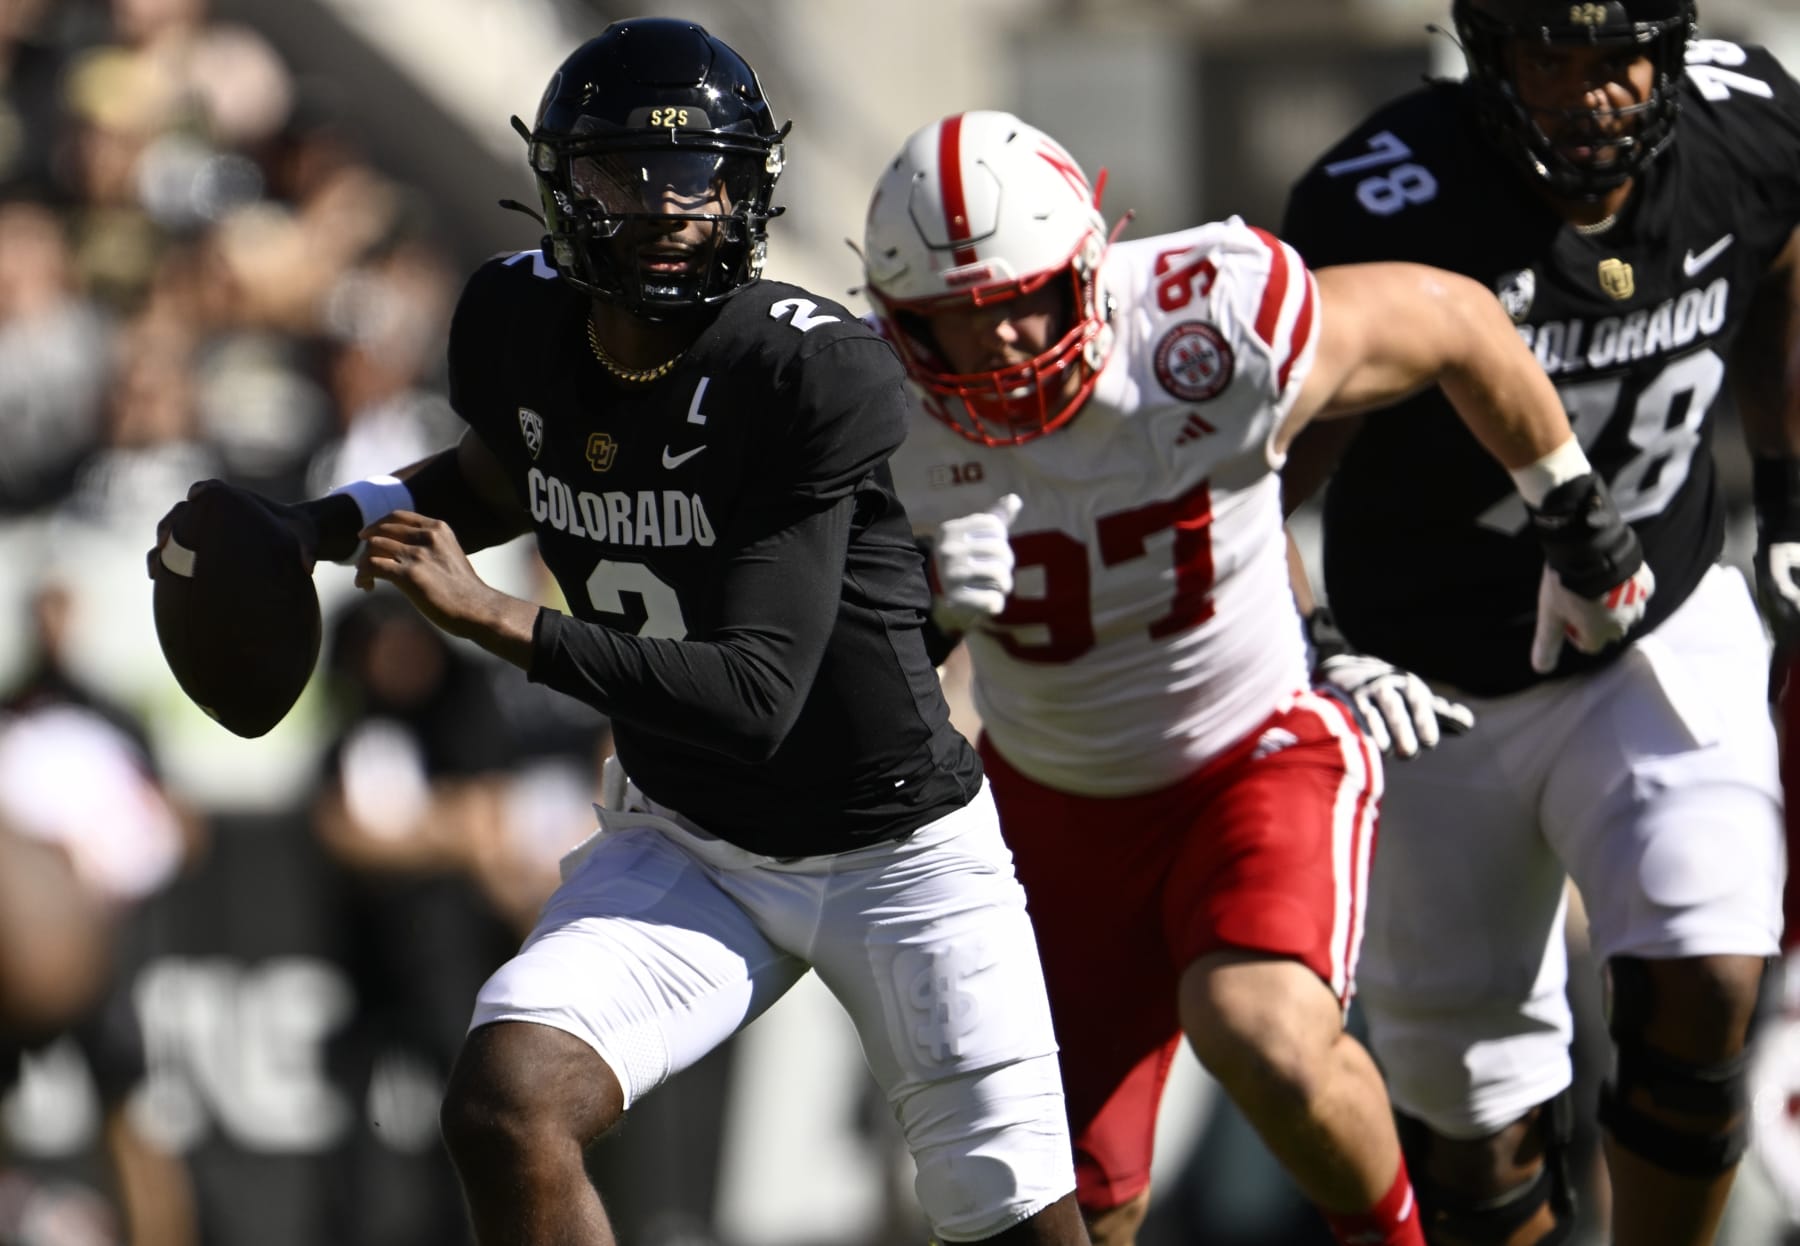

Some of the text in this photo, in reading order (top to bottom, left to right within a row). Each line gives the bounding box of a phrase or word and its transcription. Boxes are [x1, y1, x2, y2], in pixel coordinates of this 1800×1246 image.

[1325, 130, 1438, 216] 78
[769, 298, 841, 332] 2
[687, 376, 710, 426] L
[528, 467, 717, 547] COLORADO
[586, 559, 688, 641] 2
[976, 480, 1216, 666] 97
